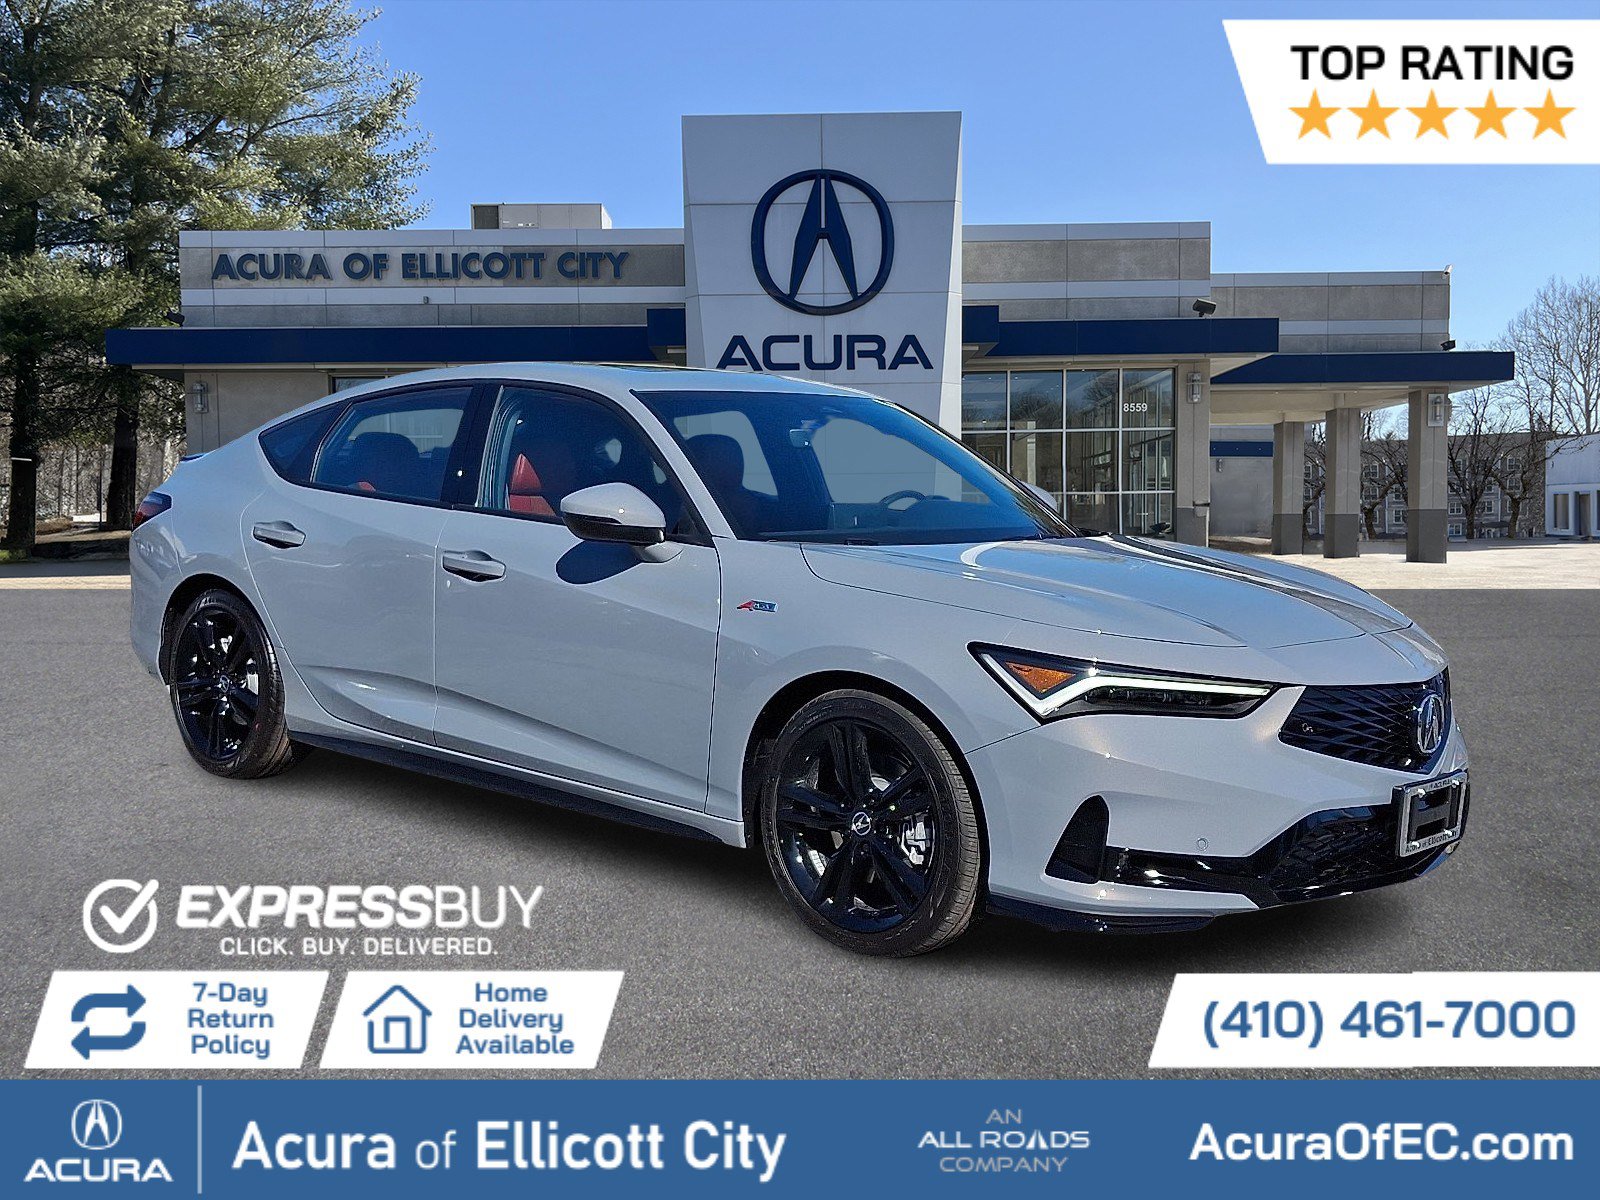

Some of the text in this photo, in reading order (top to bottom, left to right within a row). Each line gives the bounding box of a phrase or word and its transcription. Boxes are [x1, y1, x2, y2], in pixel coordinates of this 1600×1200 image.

[211, 251, 629, 280] ACURA OF ELLICOTT CITY
[716, 334, 934, 371] ACURA
[1122, 402, 1148, 412] 8559
